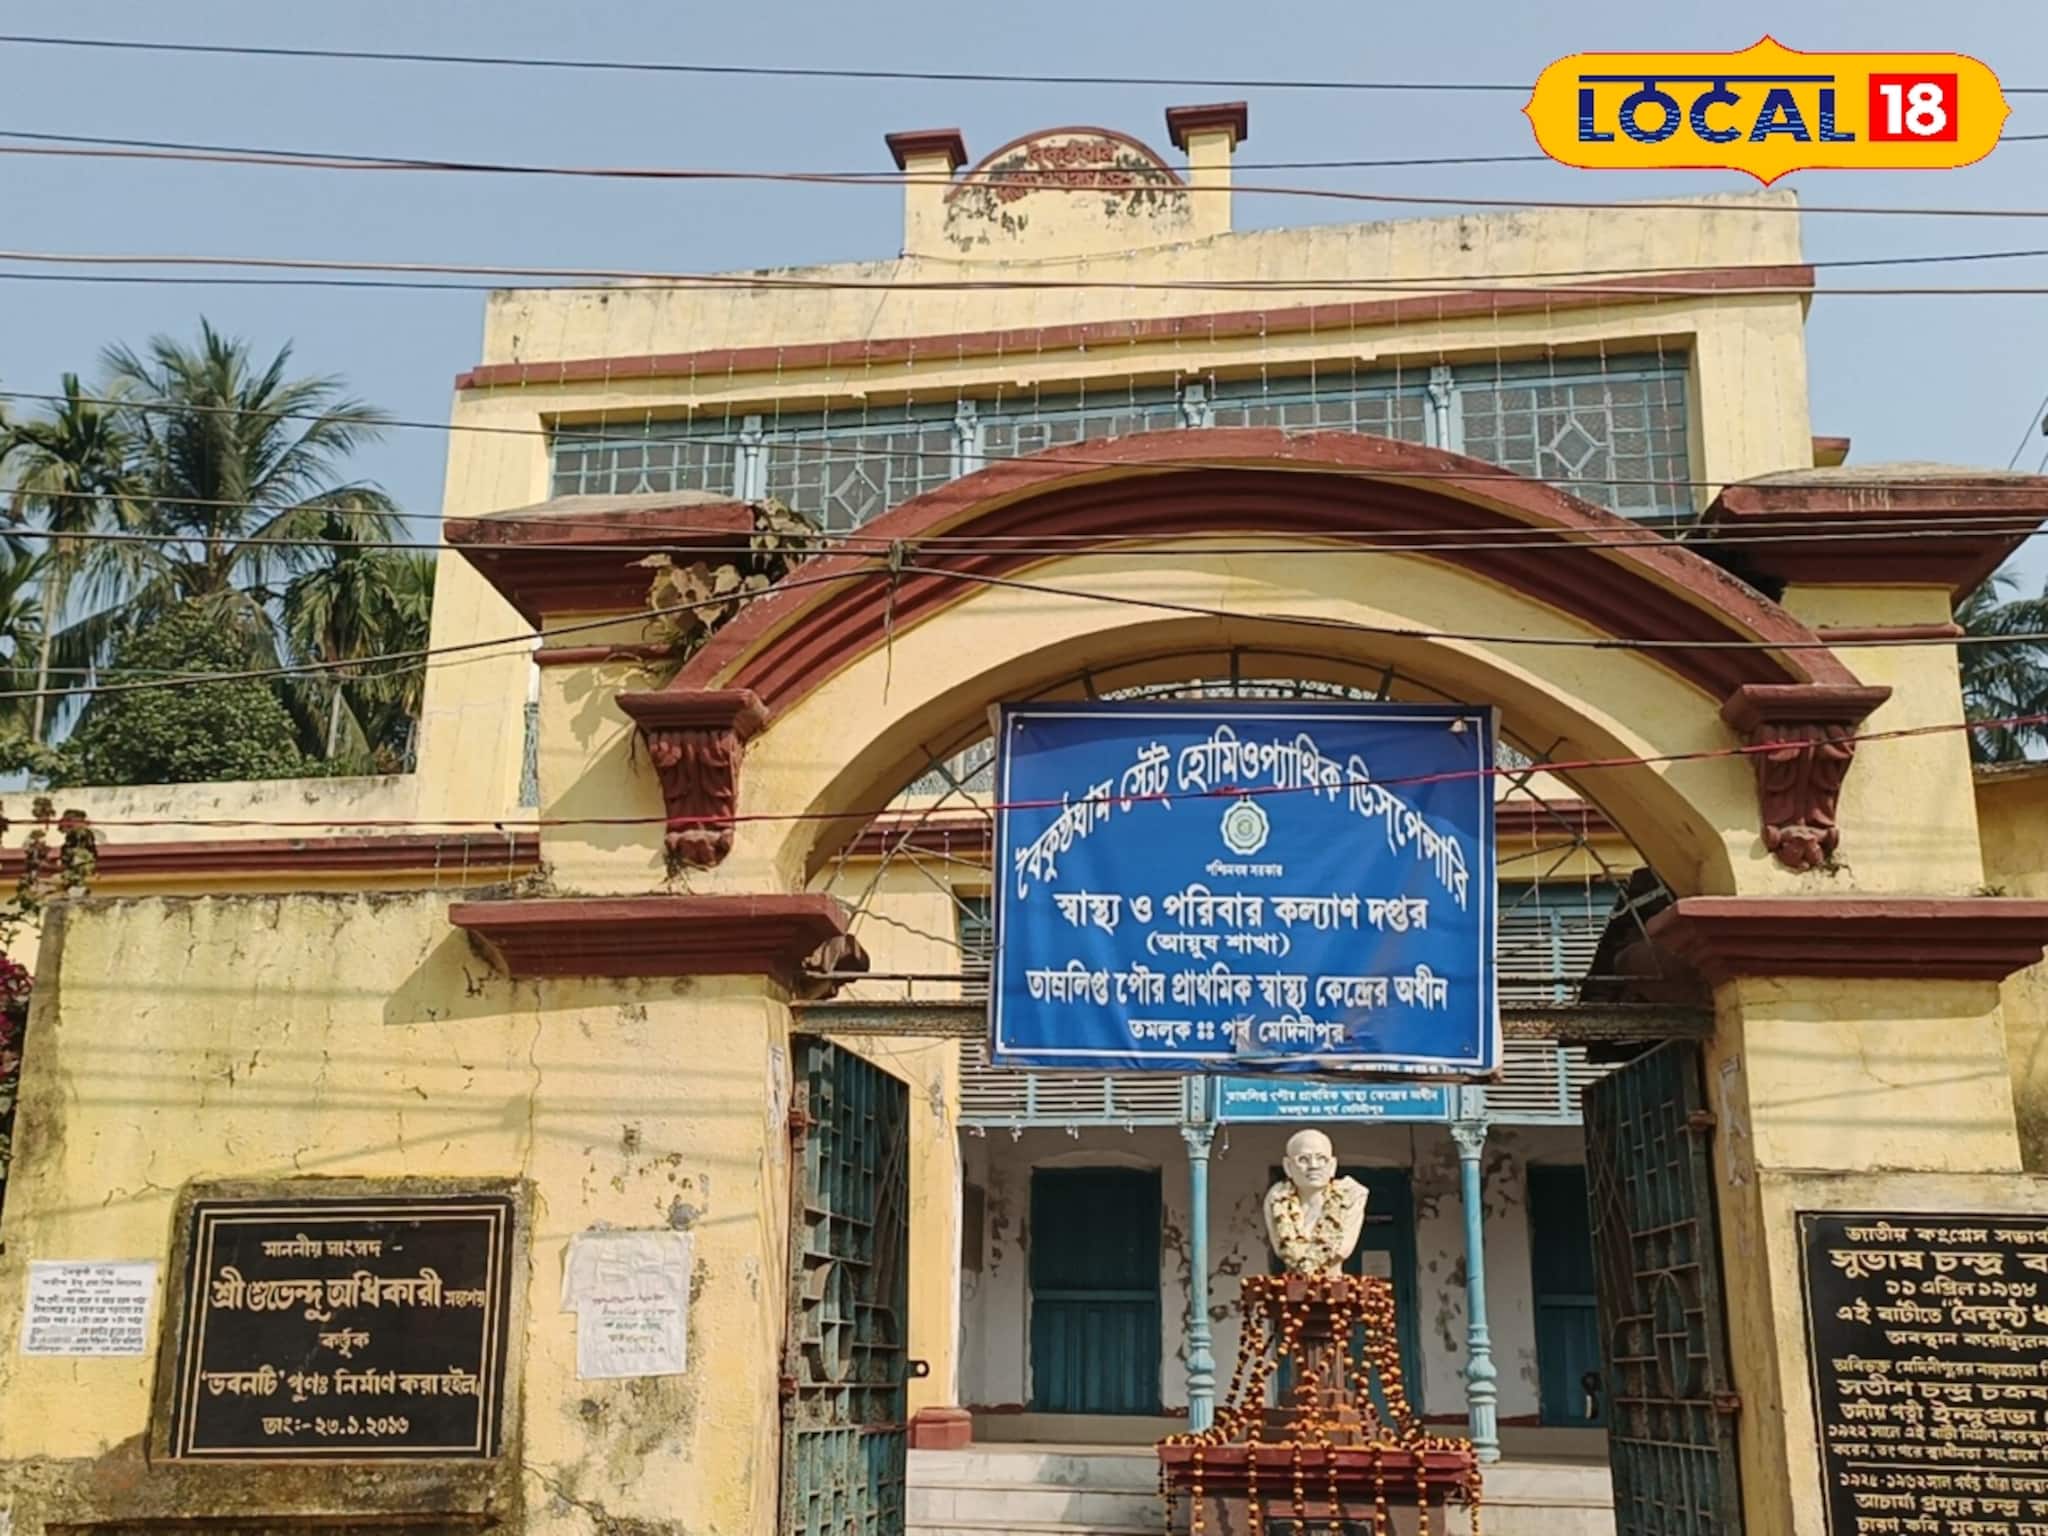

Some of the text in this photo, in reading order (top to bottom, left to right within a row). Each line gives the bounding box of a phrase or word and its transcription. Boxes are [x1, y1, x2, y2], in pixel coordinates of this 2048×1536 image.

[1177, 724, 1342, 802] হোমিওপ্যাথিক
[1251, 864, 1283, 877] সরকার
[1053, 883, 1429, 936] স্বাস্থ্য ও পরিবার কল্যাণ দপ্তর
[1147, 931, 1291, 960] (আয়ুষ শাখা)
[1026, 959, 1448, 1014] তাম্রলিপ্ত পৌর প্রাথমিক স্বাস্থ্য কেন্দ্রের অধীন
[1128, 1019, 1192, 1047] তমলুক
[1259, 1013, 1345, 1050] মেদিনীপুর
[262, 1233, 322, 1258] মাননীয়
[326, 1240, 383, 1258] সাংসদ
[1844, 1221, 1909, 1242] জাতীয়
[1914, 1227, 1988, 1244] কংগ্রেস
[1829, 1249, 1924, 1278] সুভাষ
[1931, 1251, 2004, 1276] চন্দ্র
[210, 1265, 246, 1310] শ্রী
[247, 1278, 332, 1321] শুভেন্দু
[326, 1267, 443, 1308] অধিকারী
[1885, 1275, 2037, 1297] ১১ এপ্রিল ১৯৩৪
[1836, 1297, 1872, 1324] এই
[1875, 1299, 1943, 1324] বাটীতে
[1885, 1330, 1958, 1349] অবস্থান
[334, 1367, 398, 1396] নির্মাণ
[399, 1372, 438, 1395] করা
[1836, 1374, 1914, 1396] সতীশ
[1918, 1382, 1973, 1402] চন্দ্র
[1977, 1497, 2020, 1517] চন্দ্র
